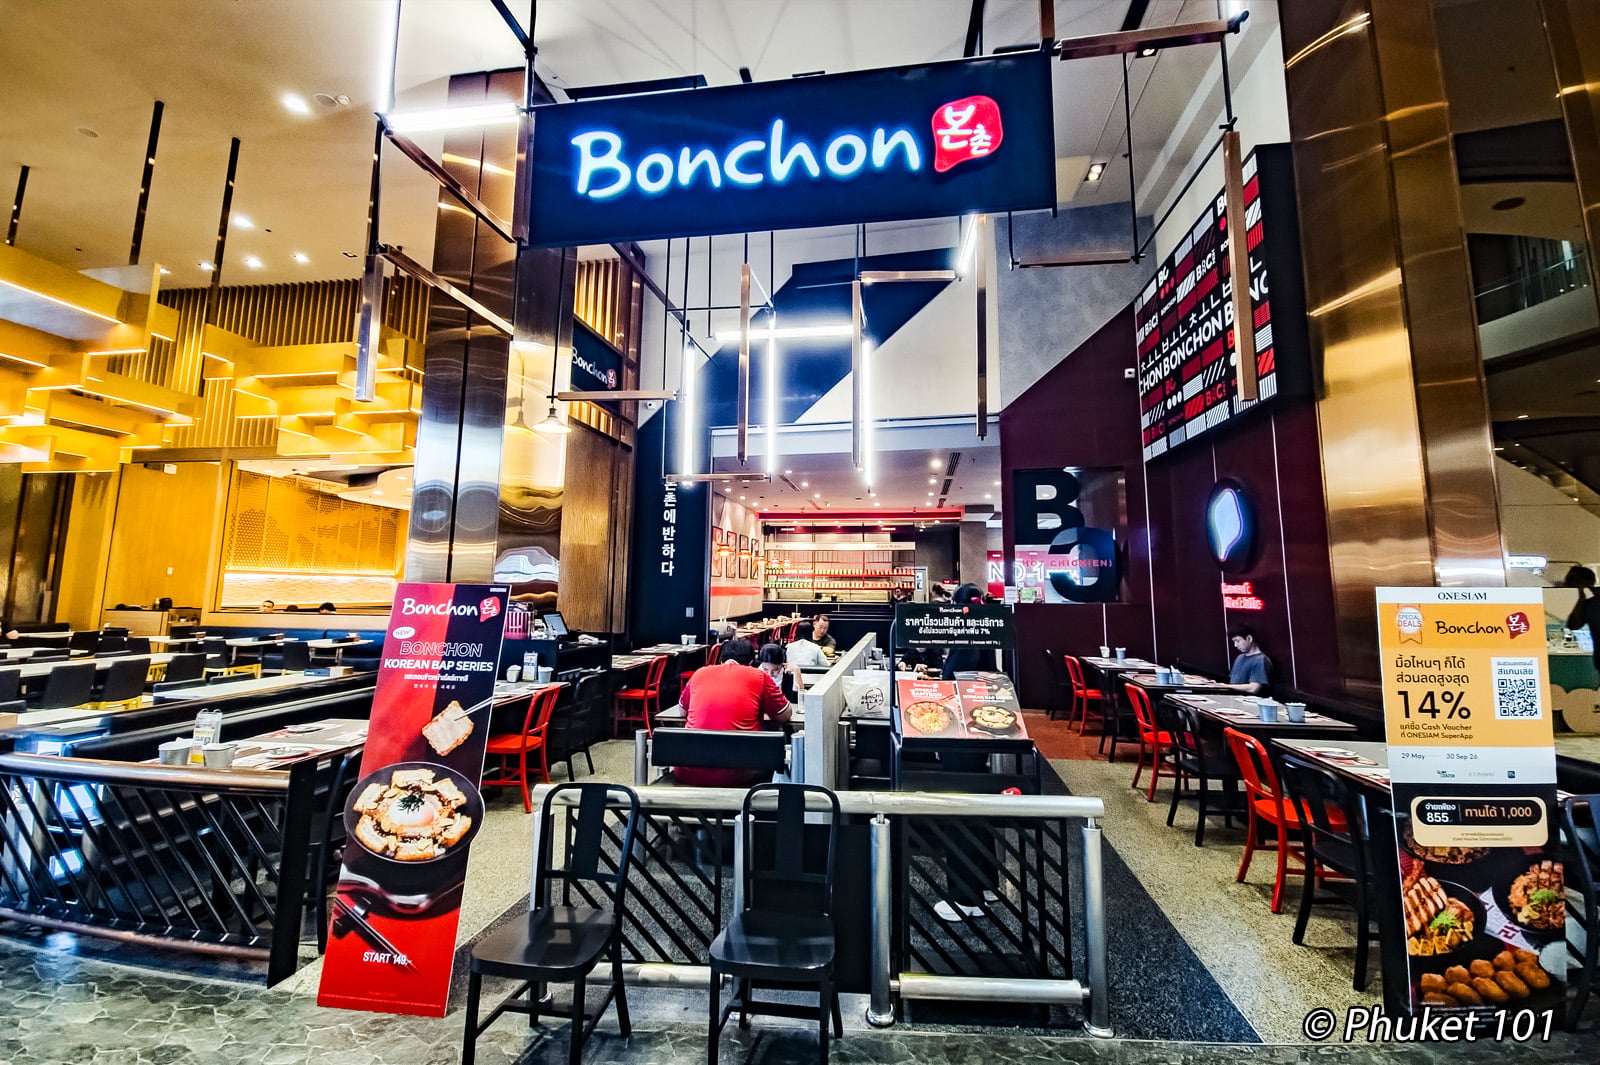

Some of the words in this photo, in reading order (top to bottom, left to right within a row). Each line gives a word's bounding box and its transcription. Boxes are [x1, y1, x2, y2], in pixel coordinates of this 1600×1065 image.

[936, 104, 993, 156] 본촌
[571, 118, 921, 198] Bonchon
[1437, 592, 1487, 601] ONESIAM
[401, 597, 479, 617] Bonchon
[1435, 620, 1504, 635] Bonchon
[400, 641, 483, 657] BONCHON
[383, 658, 430, 670] KOREAN
[431, 659, 456, 671] BAP
[455, 660, 494, 672] SERIES
[1395, 654, 1441, 671] มื้อไหนๆ
[1444, 655, 1466, 669] ก็ได้
[1497, 667, 1534, 675] สแกนเลย
[1396, 672, 1470, 687] ส่วนลดสูงสุด
[1397, 690, 1472, 720] 14%
[1421, 723, 1441, 731] Cash
[1442, 723, 1472, 731] Voucher
[1440, 732, 1474, 740] SuperApp
[1411, 752, 1426, 760] May
[1456, 753, 1468, 761] Sep
[1464, 804, 1497, 818] ทานได้
[1500, 806, 1533, 820] 1,000
[362, 951, 391, 964] START
